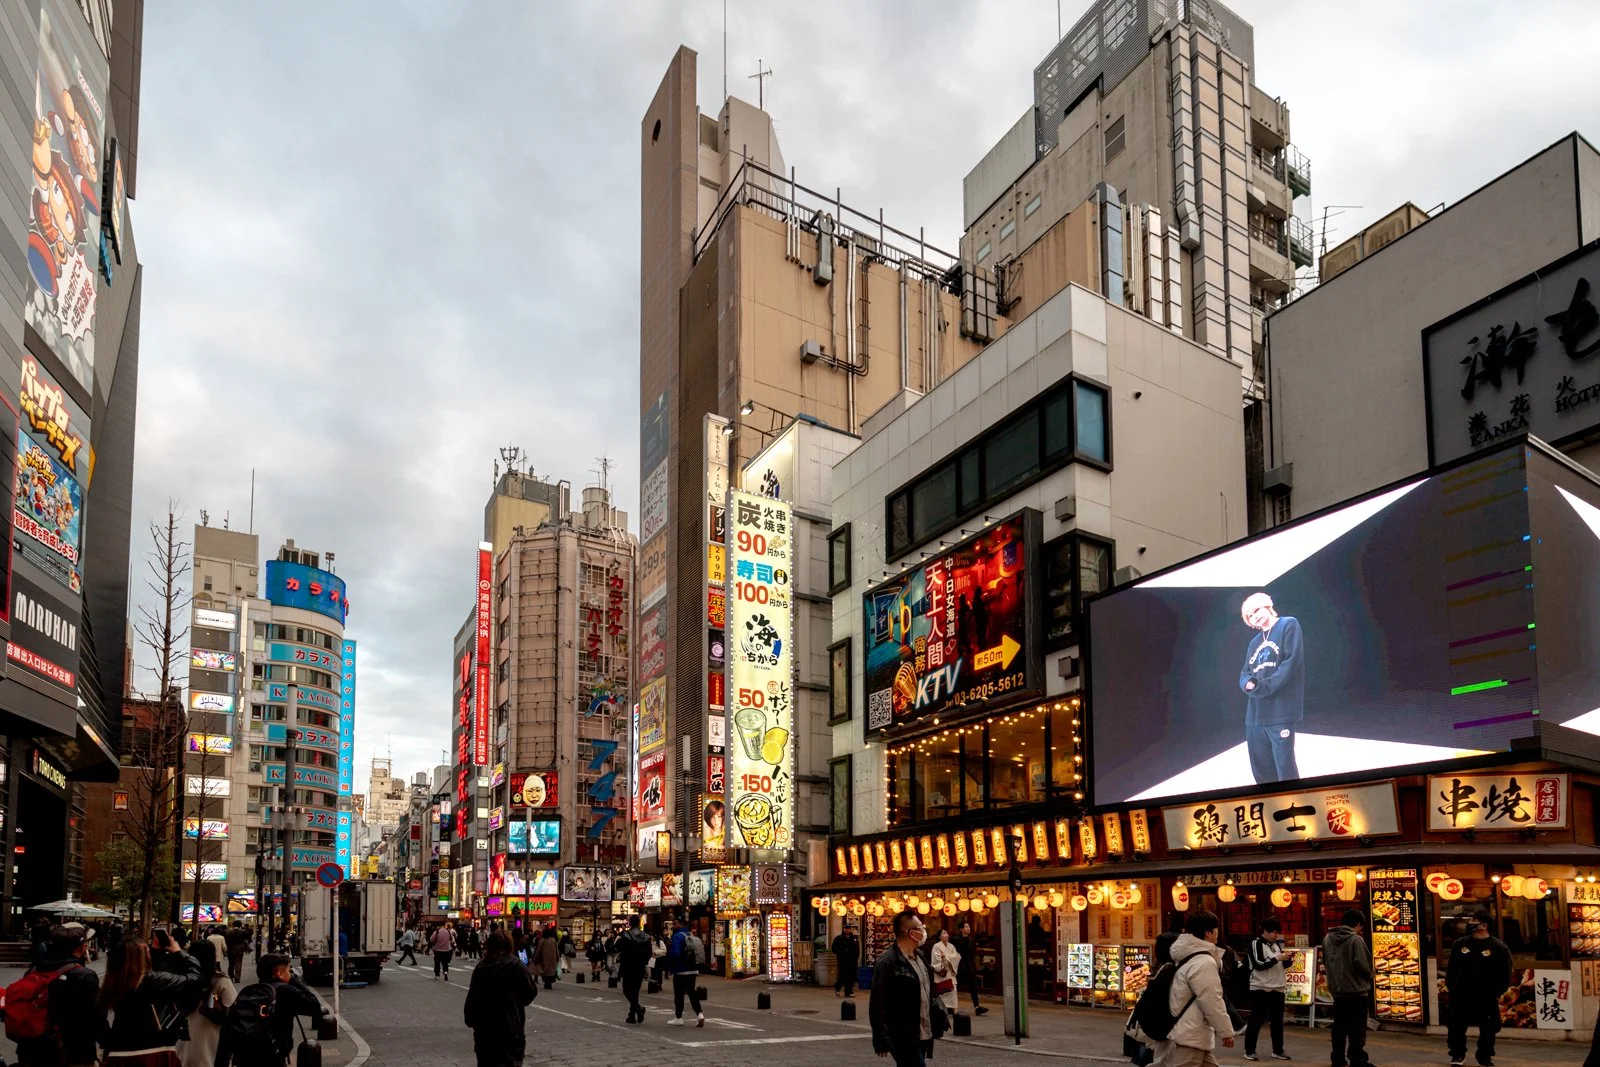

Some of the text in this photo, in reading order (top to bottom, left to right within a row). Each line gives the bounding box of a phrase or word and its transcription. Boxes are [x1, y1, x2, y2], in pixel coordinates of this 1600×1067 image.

[1470, 416, 1530, 447] KANKA
[716, 507, 725, 536] ダーツ
[737, 500, 762, 530] 炭
[737, 530, 767, 556] 90
[767, 547, 786, 559] 円から
[736, 559, 773, 585] 寿司
[286, 576, 350, 616] カラオケ
[609, 574, 624, 637] カラオケ
[735, 582, 769, 605] 100
[769, 597, 789, 609] 円から
[15, 591, 76, 651] MARUHAN
[926, 560, 944, 670] 天上人間
[745, 613, 779, 648] 海
[295, 650, 339, 670] カラオケ
[746, 652, 779, 667] ちから
[756, 642, 764, 651] の
[915, 658, 961, 709] KTV
[954, 672, 1024, 705] 03-6205-5612
[738, 688, 765, 709] 50
[587, 739, 619, 838] 747
[741, 774, 772, 794] 150
[772, 765, 789, 804] ハイボール
[1538, 781, 1556, 821] 居酒屋
[1328, 808, 1352, 834] 炭
[766, 873, 775, 882] 24
[1373, 890, 1415, 902] 炭焼き鳥
[1536, 977, 1567, 1024] 串焼
